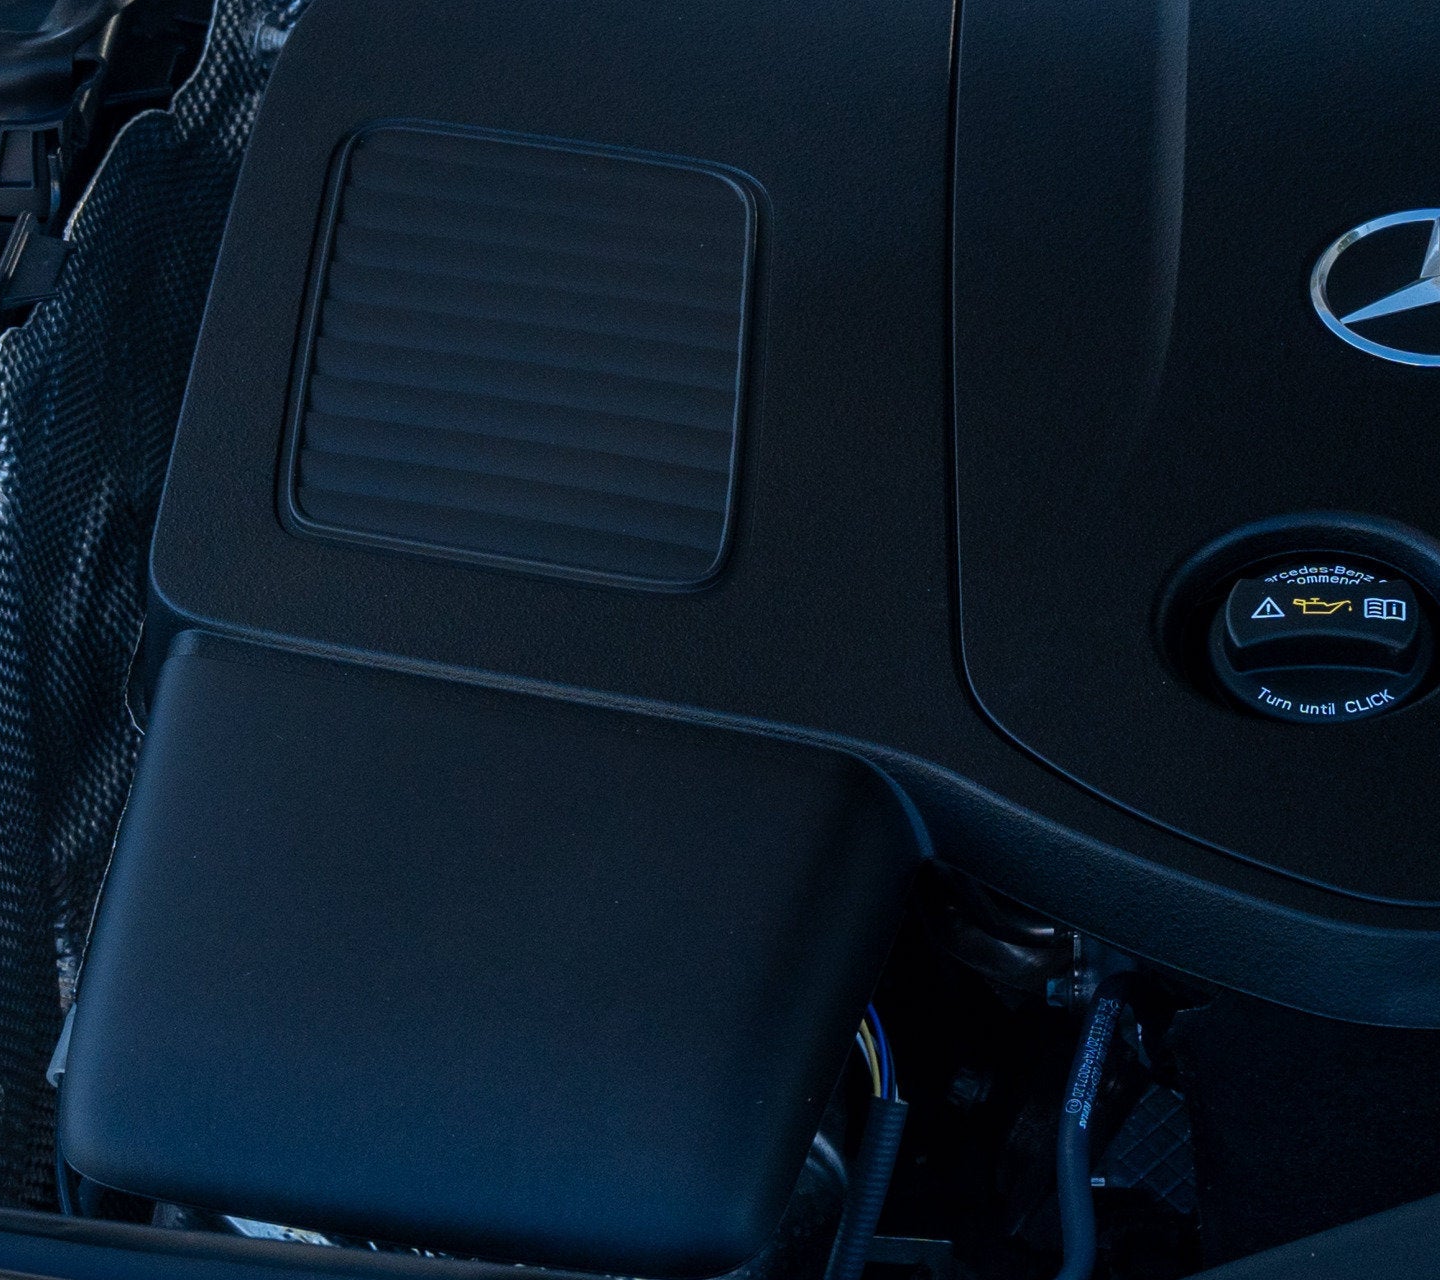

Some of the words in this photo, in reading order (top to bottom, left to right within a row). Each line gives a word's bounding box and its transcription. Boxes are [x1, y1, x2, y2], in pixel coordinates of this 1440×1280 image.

[1256, 686, 1293, 711] Turn
[1299, 702, 1336, 716] until
[1344, 688, 1395, 714] CLICK
